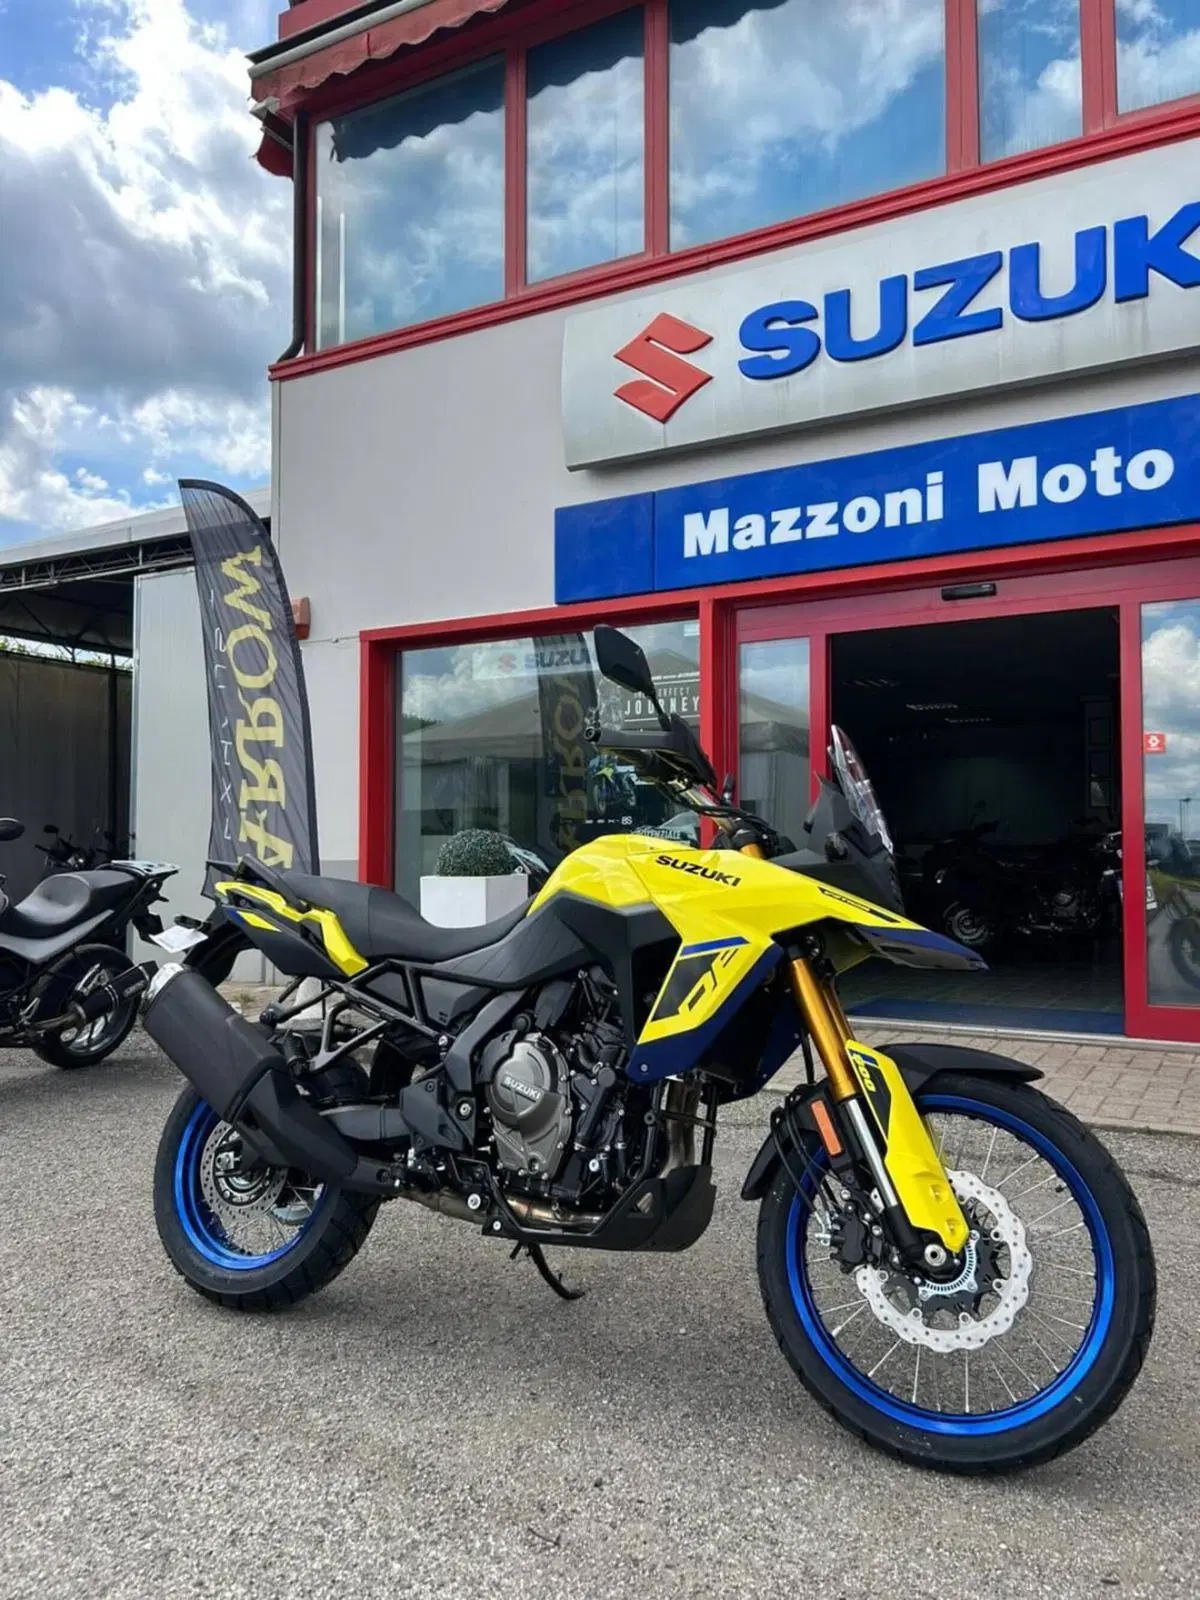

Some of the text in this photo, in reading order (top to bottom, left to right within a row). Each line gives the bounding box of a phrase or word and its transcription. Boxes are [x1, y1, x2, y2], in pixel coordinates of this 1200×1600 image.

[683, 445, 1174, 558] Mazzoni Moto
[655, 855, 742, 887] SUZUKI
[503, 1076, 541, 1100] SUZUKI
